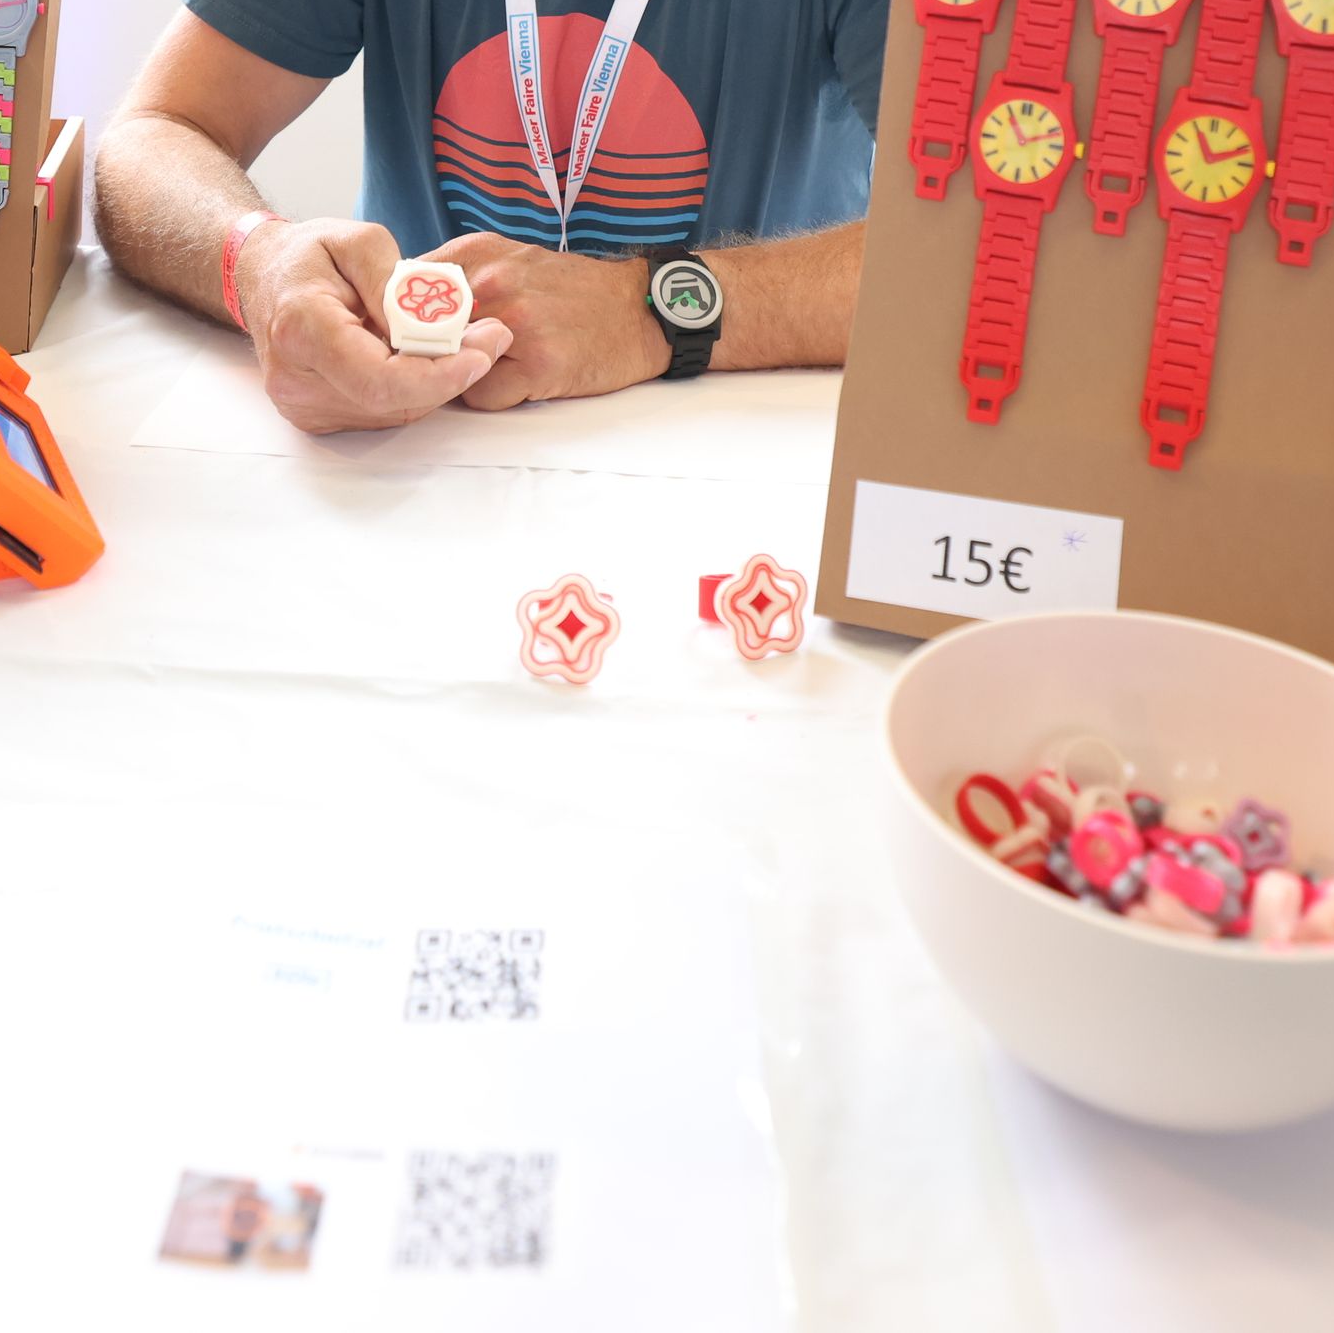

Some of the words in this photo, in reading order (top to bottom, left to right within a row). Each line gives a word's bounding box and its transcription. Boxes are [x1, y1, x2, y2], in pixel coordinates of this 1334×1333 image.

[518, 20, 532, 75] Vienna
[591, 44, 619, 92] Vienna
[523, 78, 535, 115] Faire
[581, 96, 602, 128] Faire
[529, 119, 549, 164] Maker
[573, 131, 591, 177] Maker
[931, 535, 1033, 594] 15€
